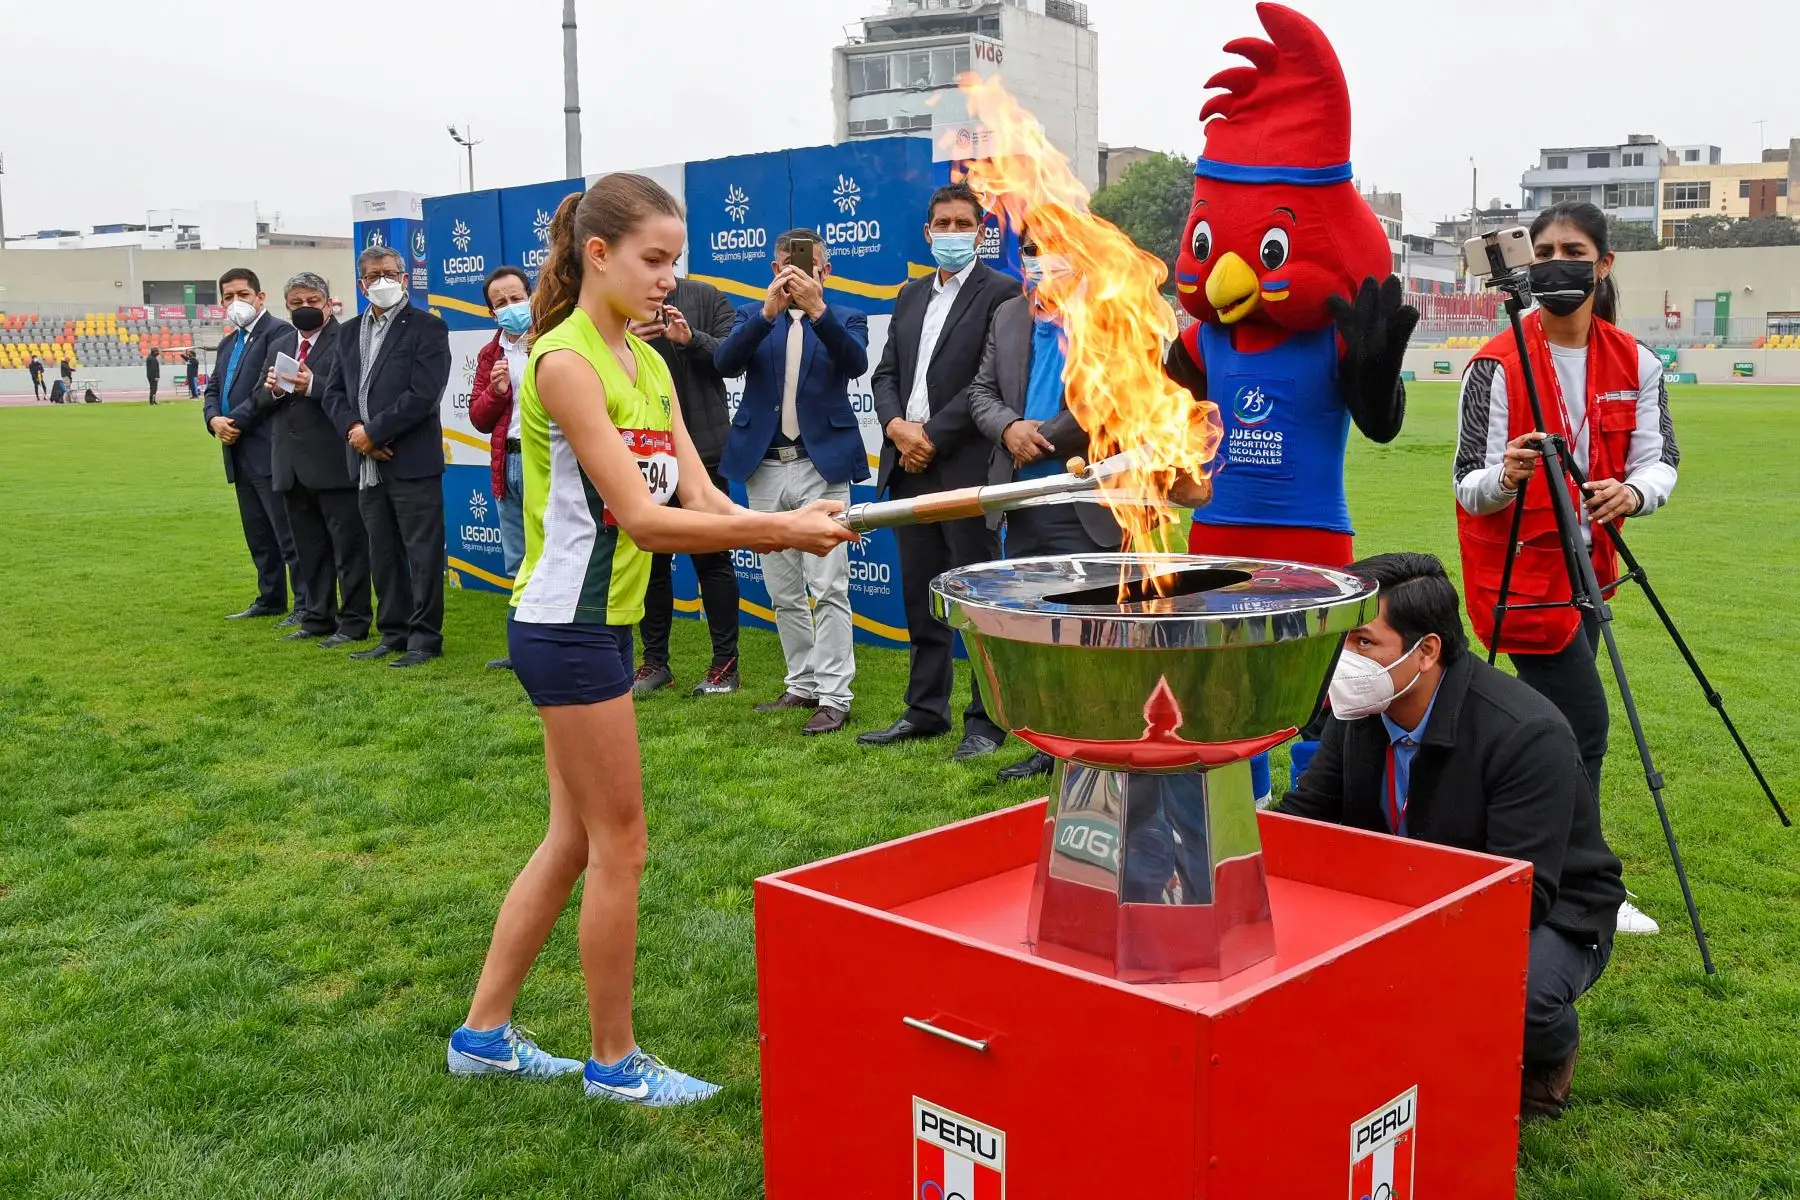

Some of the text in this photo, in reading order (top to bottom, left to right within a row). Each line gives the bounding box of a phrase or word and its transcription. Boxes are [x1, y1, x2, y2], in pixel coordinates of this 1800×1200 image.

[710, 228, 767, 250] LEGADO
[443, 254, 485, 275] LEGADO
[711, 249, 766, 263] Seguimos jugando
[1229, 428, 1284, 442] JUEGOS
[1228, 447, 1282, 457] ESCOLARES
[460, 525, 502, 544] LEGADO
[863, 584, 890, 596] jugando
[921, 1109, 997, 1160] PERU
[1356, 1099, 1411, 1153] PERU
